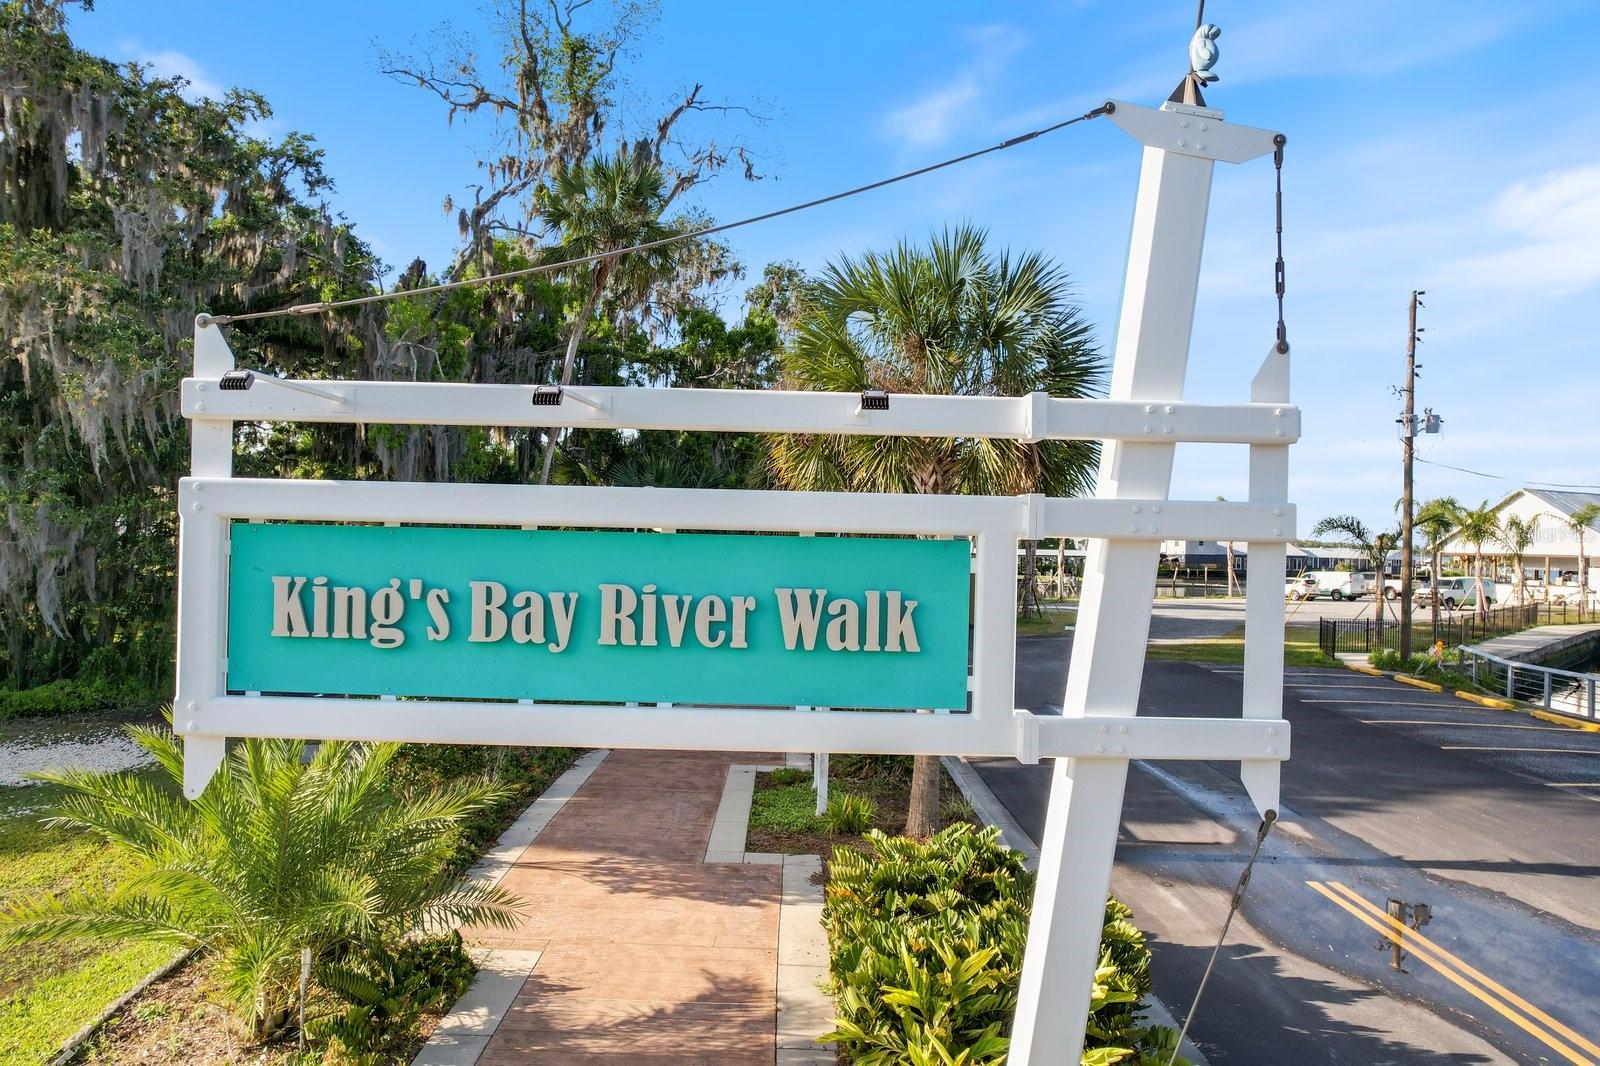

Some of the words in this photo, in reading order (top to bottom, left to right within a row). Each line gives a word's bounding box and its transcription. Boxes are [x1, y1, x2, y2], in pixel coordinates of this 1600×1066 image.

[271, 575, 450, 649] King's
[468, 581, 579, 654] Bay
[597, 584, 757, 650] River
[776, 587, 922, 654] Walk
